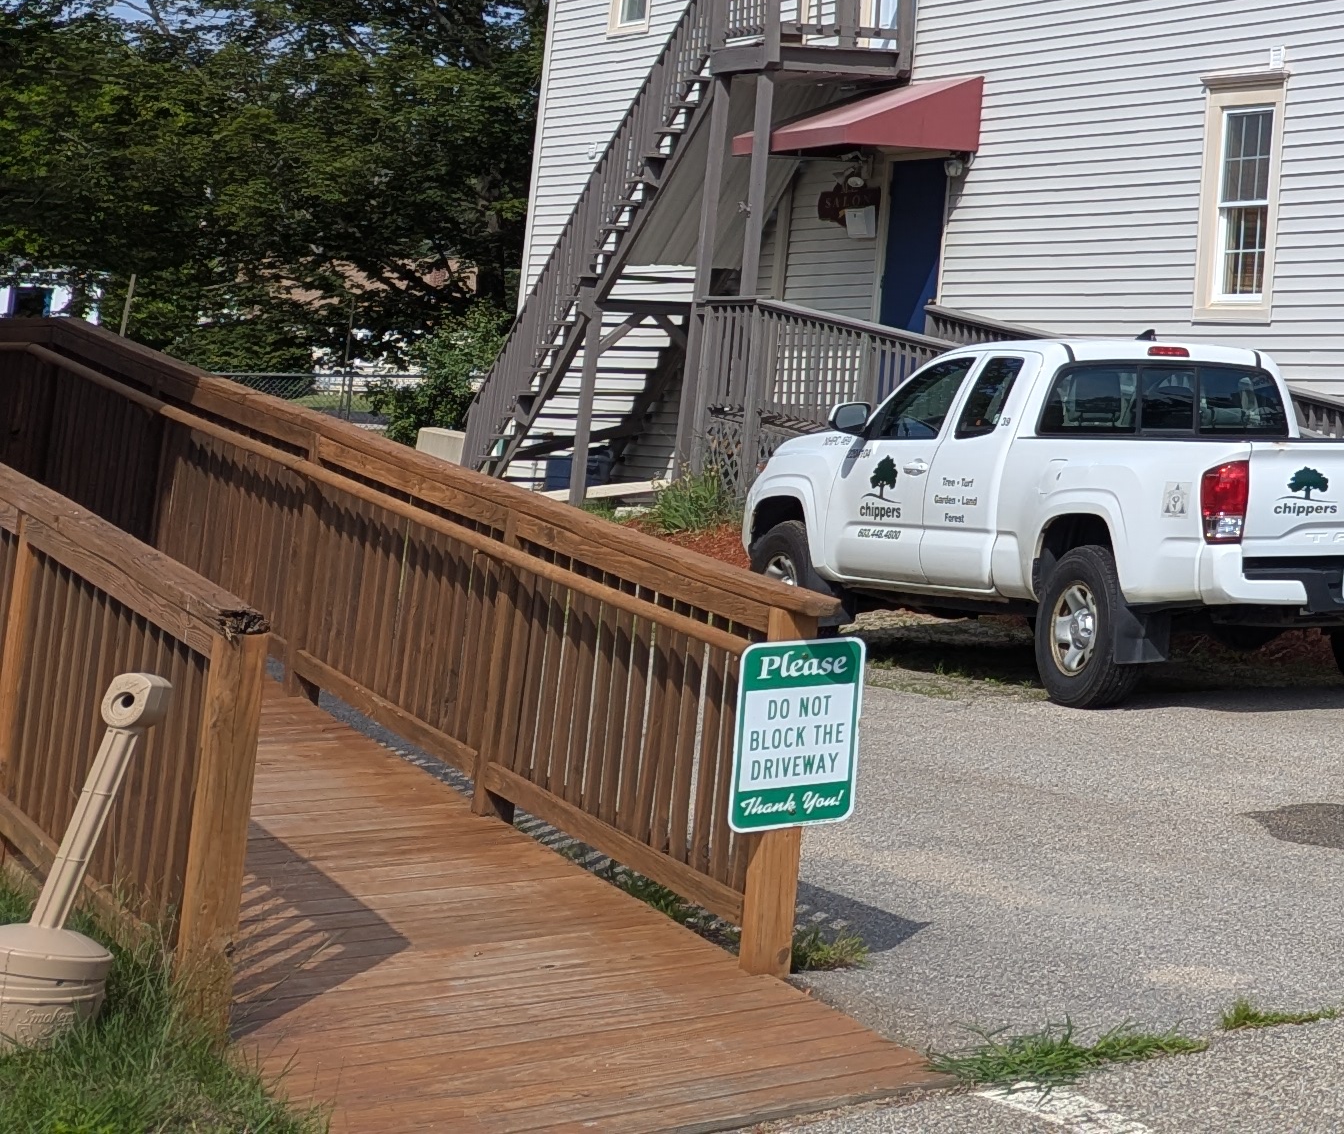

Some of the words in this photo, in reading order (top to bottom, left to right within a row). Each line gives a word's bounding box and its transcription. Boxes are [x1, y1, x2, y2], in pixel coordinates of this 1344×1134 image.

[860, 502, 902, 521] chippers
[1273, 502, 1338, 517] chippers
[757, 650, 848, 680] Please
[767, 698, 790, 721] DO
[799, 695, 832, 718] NOT
[749, 726, 806, 752] BLOCK
[813, 722, 845, 746] THE
[750, 752, 840, 782] DRIVEWAY
[740, 792, 796, 817] Thank
[802, 789, 845, 815] You!
